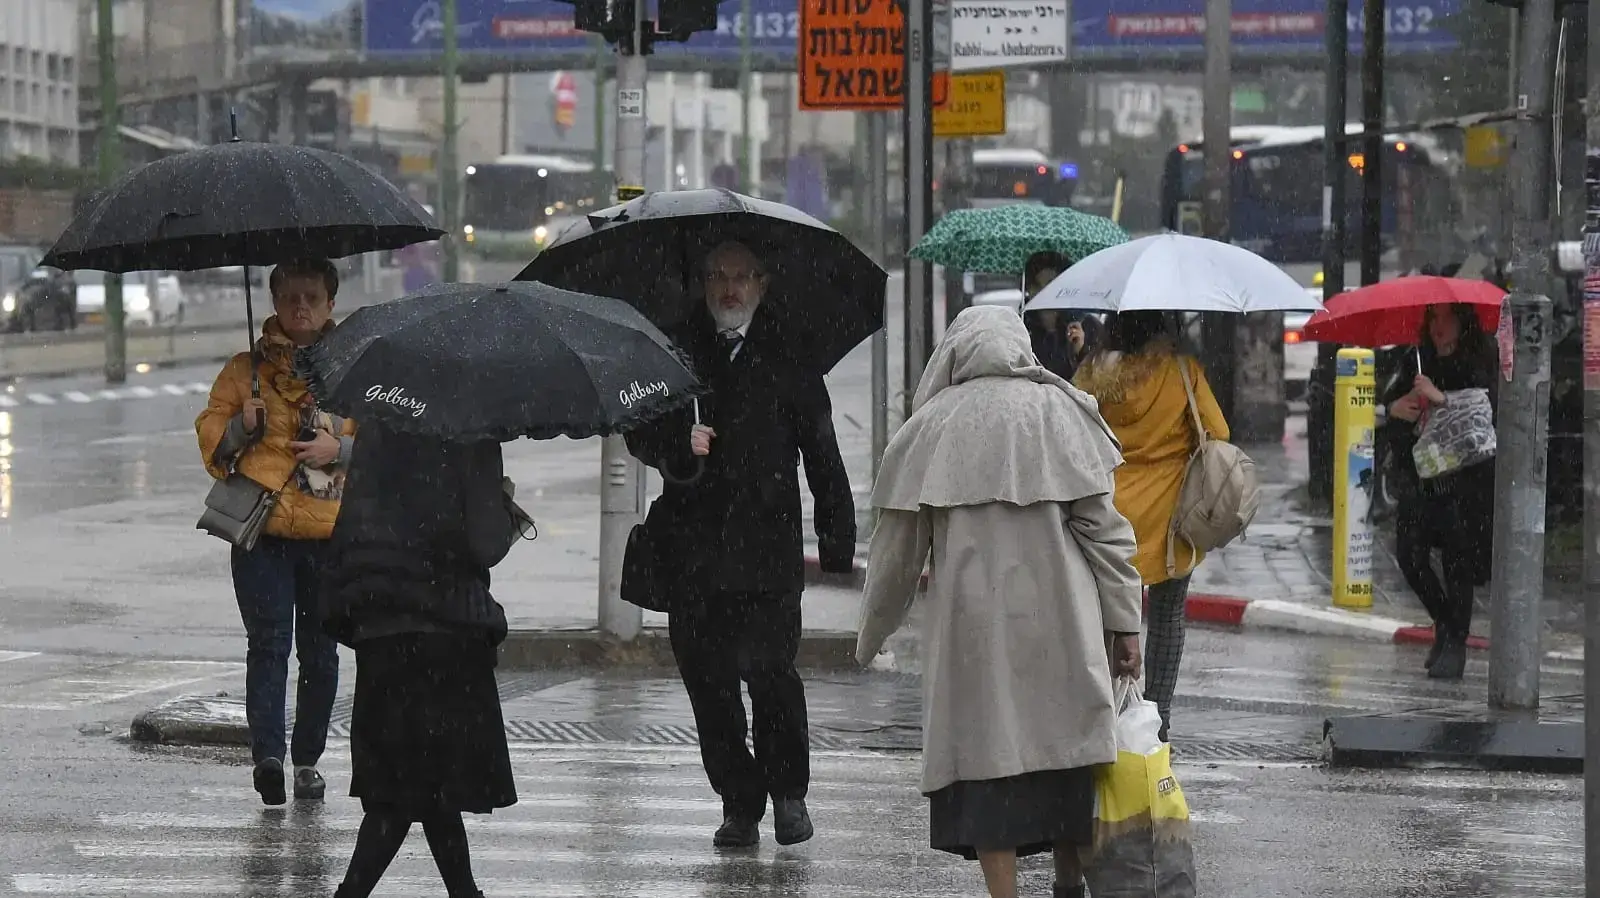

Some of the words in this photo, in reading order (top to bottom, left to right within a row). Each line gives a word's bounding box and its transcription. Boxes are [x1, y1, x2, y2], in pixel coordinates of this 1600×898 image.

[809, 22, 904, 57] שתלבות
[815, 62, 905, 97] שמאל
[364, 384, 427, 417] Golbary
[619, 379, 670, 409] Golbary
